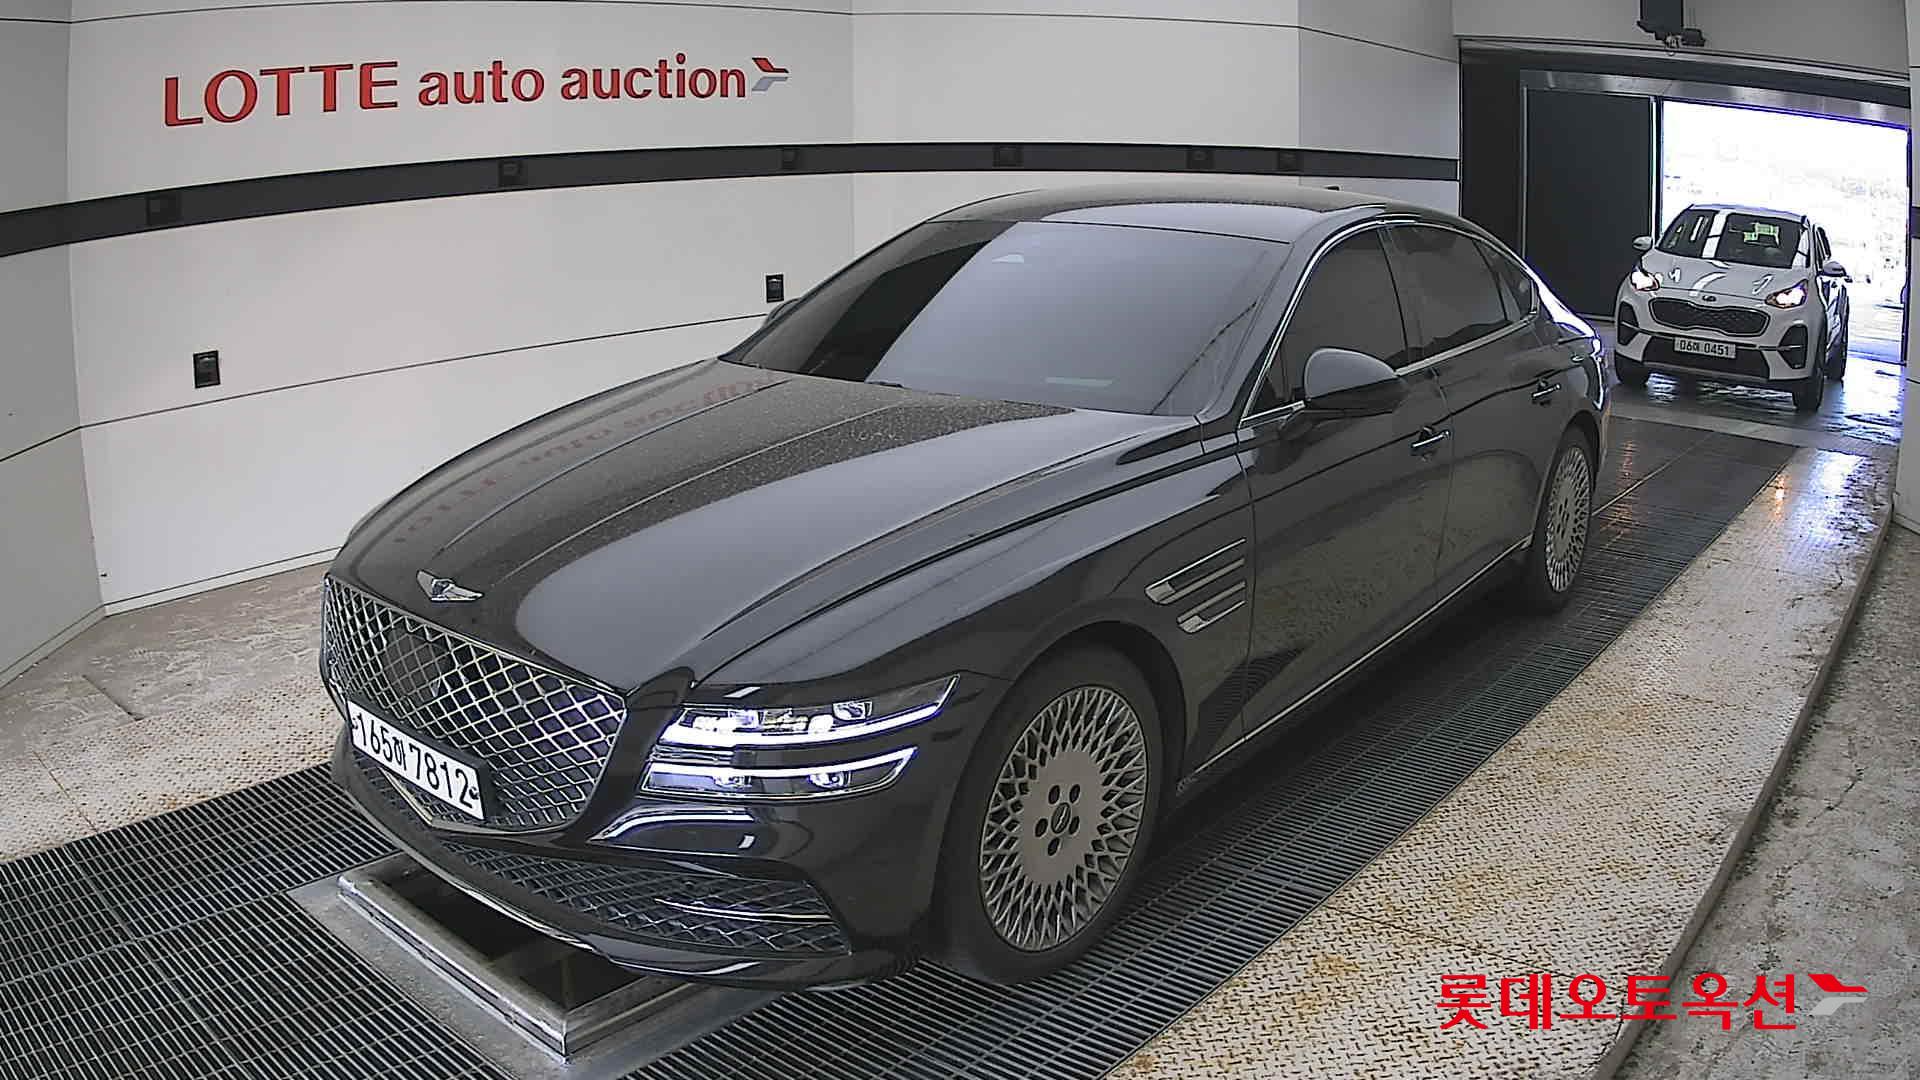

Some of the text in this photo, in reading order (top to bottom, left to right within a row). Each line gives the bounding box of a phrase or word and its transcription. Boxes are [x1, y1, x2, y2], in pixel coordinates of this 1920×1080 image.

[164, 53, 747, 127] LOTTE auto auction
[1704, 343, 1728, 356] 0451
[409, 743, 473, 809] 7812
